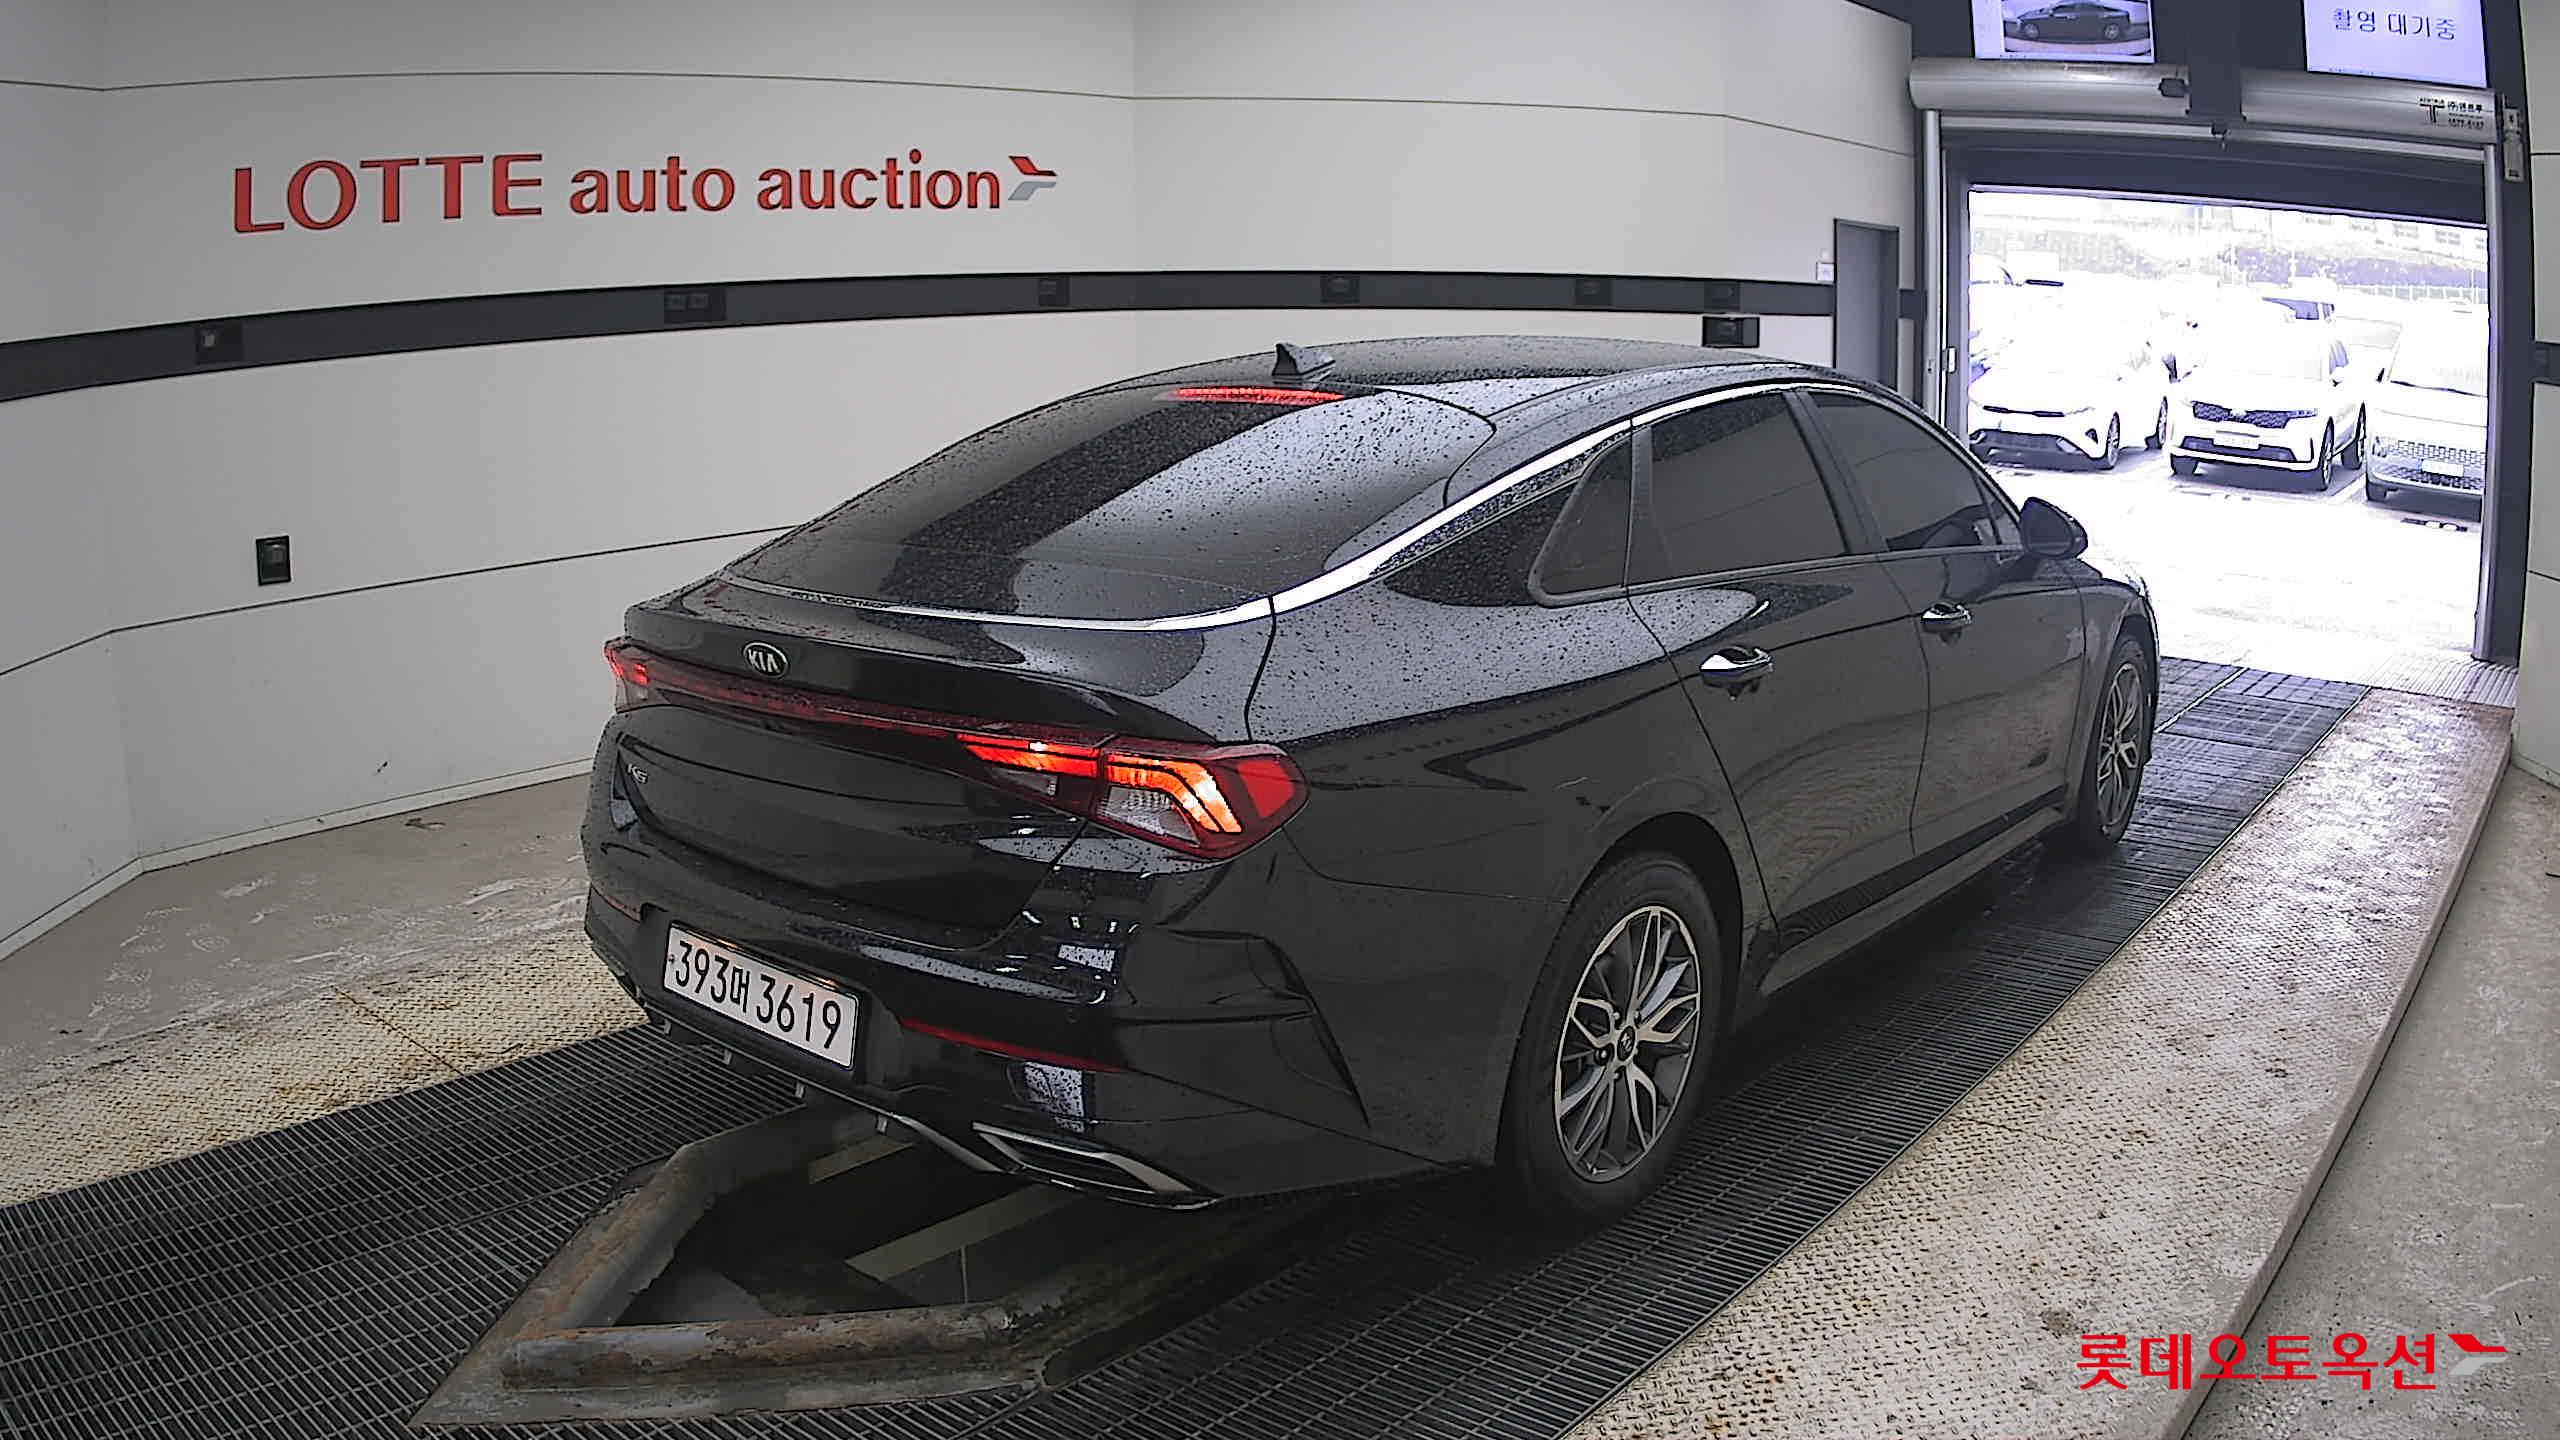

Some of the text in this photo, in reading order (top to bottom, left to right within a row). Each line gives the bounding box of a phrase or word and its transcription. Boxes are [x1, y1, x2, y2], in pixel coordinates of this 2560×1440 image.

[2333, 8, 2456, 40] 촬영 대기중
[235, 148, 1001, 233] LOTTE auto auction
[747, 647, 783, 675] KIA
[756, 974, 841, 1048] 3619
